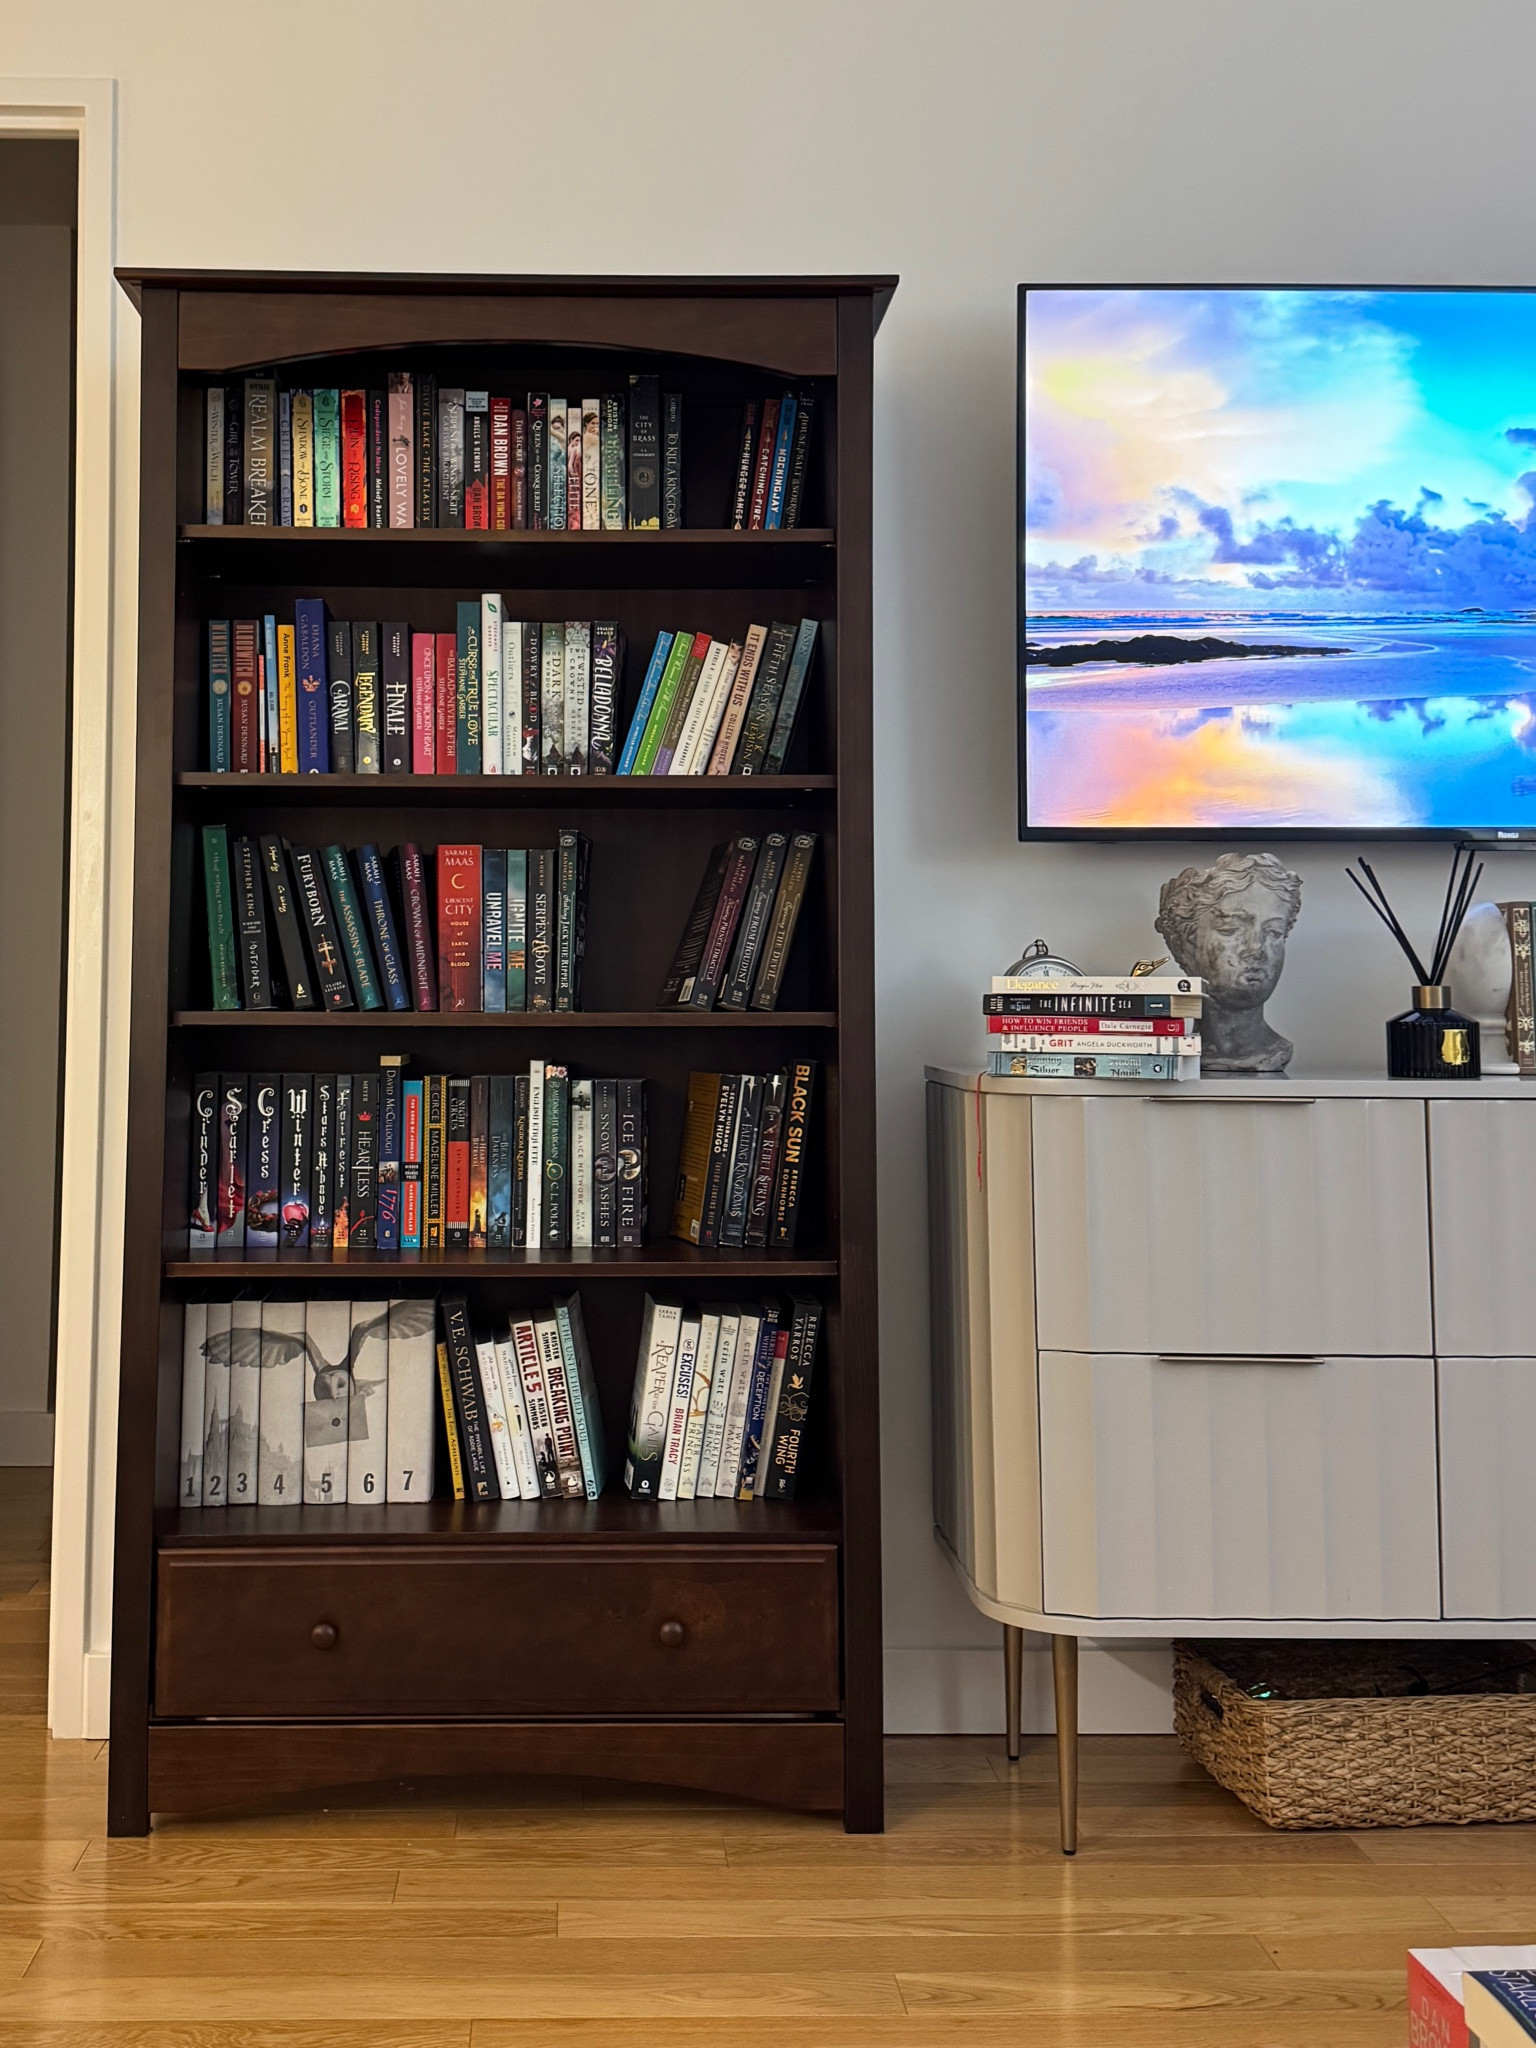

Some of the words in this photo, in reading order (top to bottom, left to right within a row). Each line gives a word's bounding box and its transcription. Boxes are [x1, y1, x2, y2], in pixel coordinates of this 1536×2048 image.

[250, 393, 267, 451] REALM
[319, 418, 333, 450] SIEGE
[422, 421, 431, 448] BLAKE
[493, 414, 508, 436] DAN
[533, 420, 543, 448] QUEEN
[635, 421, 653, 429] CITY
[668, 432, 679, 444] TO
[297, 418, 309, 460] SHADOW
[633, 435, 656, 443] BRASS
[395, 448, 408, 498] LOVELY
[423, 456, 431, 473] THE
[493, 438, 508, 476] BROWN
[666, 447, 677, 467] KILL
[757, 448, 770, 495] CATCHING
[297, 470, 309, 500] BONE
[320, 461, 334, 499] STORM
[348, 461, 361, 501] RISING
[374, 478, 383, 503] Melody
[422, 479, 431, 505] ATLAS
[496, 478, 505, 489] THE
[496, 490, 505, 500] DA
[585, 473, 597, 512] ONE
[770, 448, 787, 513] MOCKINGJAY
[423, 507, 431, 521] SIX
[496, 501, 505, 519] VINCI
[666, 477, 677, 529] KINGDOM
[753, 498, 764, 520] FIRE
[423, 648, 431, 669] ONCE
[530, 638, 538, 679] DOWRY
[743, 644, 758, 668] ENDS
[447, 658, 455, 690] BALLAD
[551, 657, 562, 699] DARK
[737, 669, 751, 693] WITH
[330, 680, 350, 734] CARAVAL
[356, 672, 377, 734] LEGENDARY
[386, 682, 407, 736] FINALE
[467, 678, 479, 711] TRUE
[487, 670, 500, 737] SPECTACULAR
[592, 655, 614, 751] BELLADONNA
[732, 693, 744, 706] US
[755, 676, 777, 722] SEASON
[216, 698, 224, 724] SUSAN
[241, 699, 249, 724] SUSAN
[447, 697, 455, 726] NEVER
[216, 725, 224, 763] DENNARD
[309, 701, 318, 759] OUTLANDER
[467, 713, 479, 746] LOVE
[724, 714, 737, 742] COLLEEN
[240, 726, 248, 764] DENNARD
[243, 847, 254, 890] STEPHEN
[328, 860, 338, 881] MAAS
[364, 862, 374, 883] MAAS
[405, 860, 413, 881] MAAS
[445, 857, 474, 866] MAAS
[247, 892, 256, 917] KING
[297, 854, 327, 927] FURYBORN
[410, 889, 423, 928] CROWN
[445, 904, 474, 915] CITY
[486, 892, 502, 948] UNRAVEL
[509, 898, 526, 944] IGNITE
[373, 899, 390, 940] THRONE
[384, 951, 399, 985] GLASS
[749, 915, 761, 942] FROM
[342, 904, 363, 956] ASSASSIN'S
[355, 954, 371, 988] BLADE
[486, 951, 502, 971] ME
[509, 949, 525, 970] ME
[561, 941, 569, 958] THE
[738, 939, 755, 984] HOUDINI
[249, 944, 260, 989] OUTSIDER
[415, 939, 429, 991] MIDNIGHT
[560, 959, 569, 989] RIPPER
[1006, 978, 1058, 990] Elegance
[1040, 1000, 1052, 1008] THE
[1055, 996, 1116, 1012] INFINITE
[1120, 1022, 1152, 1031] Carnegie
[1049, 1039, 1074, 1047] GRIT
[385, 1069, 397, 1096] DAVID
[1030, 1065, 1061, 1074] Silver
[431, 1093, 440, 1121] CIRCE
[718, 1085, 730, 1122] EVELYN
[789, 1064, 811, 1124] BLACK
[197, 1089, 214, 1195] Cinder
[257, 1087, 275, 1179] Cress
[287, 1088, 308, 1196] Winter
[600, 1113, 610, 1151] SNOW
[622, 1114, 635, 1143] ICE
[713, 1124, 725, 1154] HUGO
[225, 1087, 243, 1219] Scarlet
[431, 1131, 440, 1180] MADELINE
[784, 1126, 803, 1164] SUN
[352, 1131, 374, 1199] HEARTLESS
[430, 1182, 439, 1216] MILLER
[576, 1163, 584, 1205] NETWORK
[788, 1169, 799, 1208] REBECCA
[379, 1189, 398, 1224] 1776
[550, 1203, 559, 1227] POLK
[600, 1185, 610, 1227] ASHES
[621, 1186, 634, 1227] FIRE
[449, 1310, 463, 1325] V.
[452, 1327, 466, 1343] E.
[550, 1331, 561, 1360] KRISTEN
[790, 1318, 804, 1361] YARROS
[801, 1315, 818, 1367] REBECCA
[516, 1325, 538, 1378] ARTICLE
[455, 1346, 479, 1421] SCHWAB
[526, 1383, 542, 1393] 5
[561, 1323, 571, 1346] THE
[566, 1347, 583, 1415] UNTETHERED
[577, 1417, 587, 1444] SOUL
[676, 1352, 694, 1399] EXCUSES!
[548, 1366, 570, 1424] BREAKING
[752, 1371, 766, 1421] DECEPTION
[528, 1398, 541, 1430] SIMMONS
[536, 1397, 548, 1428] KRISTEN
[670, 1407, 685, 1435] BRIAN
[557, 1427, 575, 1459] POINT
[667, 1436, 681, 1465] TRACY
[683, 1422, 694, 1473] PRINCESS
[711, 1424, 722, 1468] BROKEN
[775, 1435, 789, 1465] WING
[784, 1428, 800, 1474] FOURTH
[186, 1477, 195, 1497] 1
[209, 1476, 221, 1496] 2
[236, 1473, 248, 1493] 3
[273, 1474, 285, 1495] 4
[321, 1473, 332, 1493] 5
[363, 1473, 375, 1493] 6
[402, 1471, 414, 1491] 7
[1410, 2009, 1446, 2048] BRO
[1421, 1996, 1450, 2044] DAN
